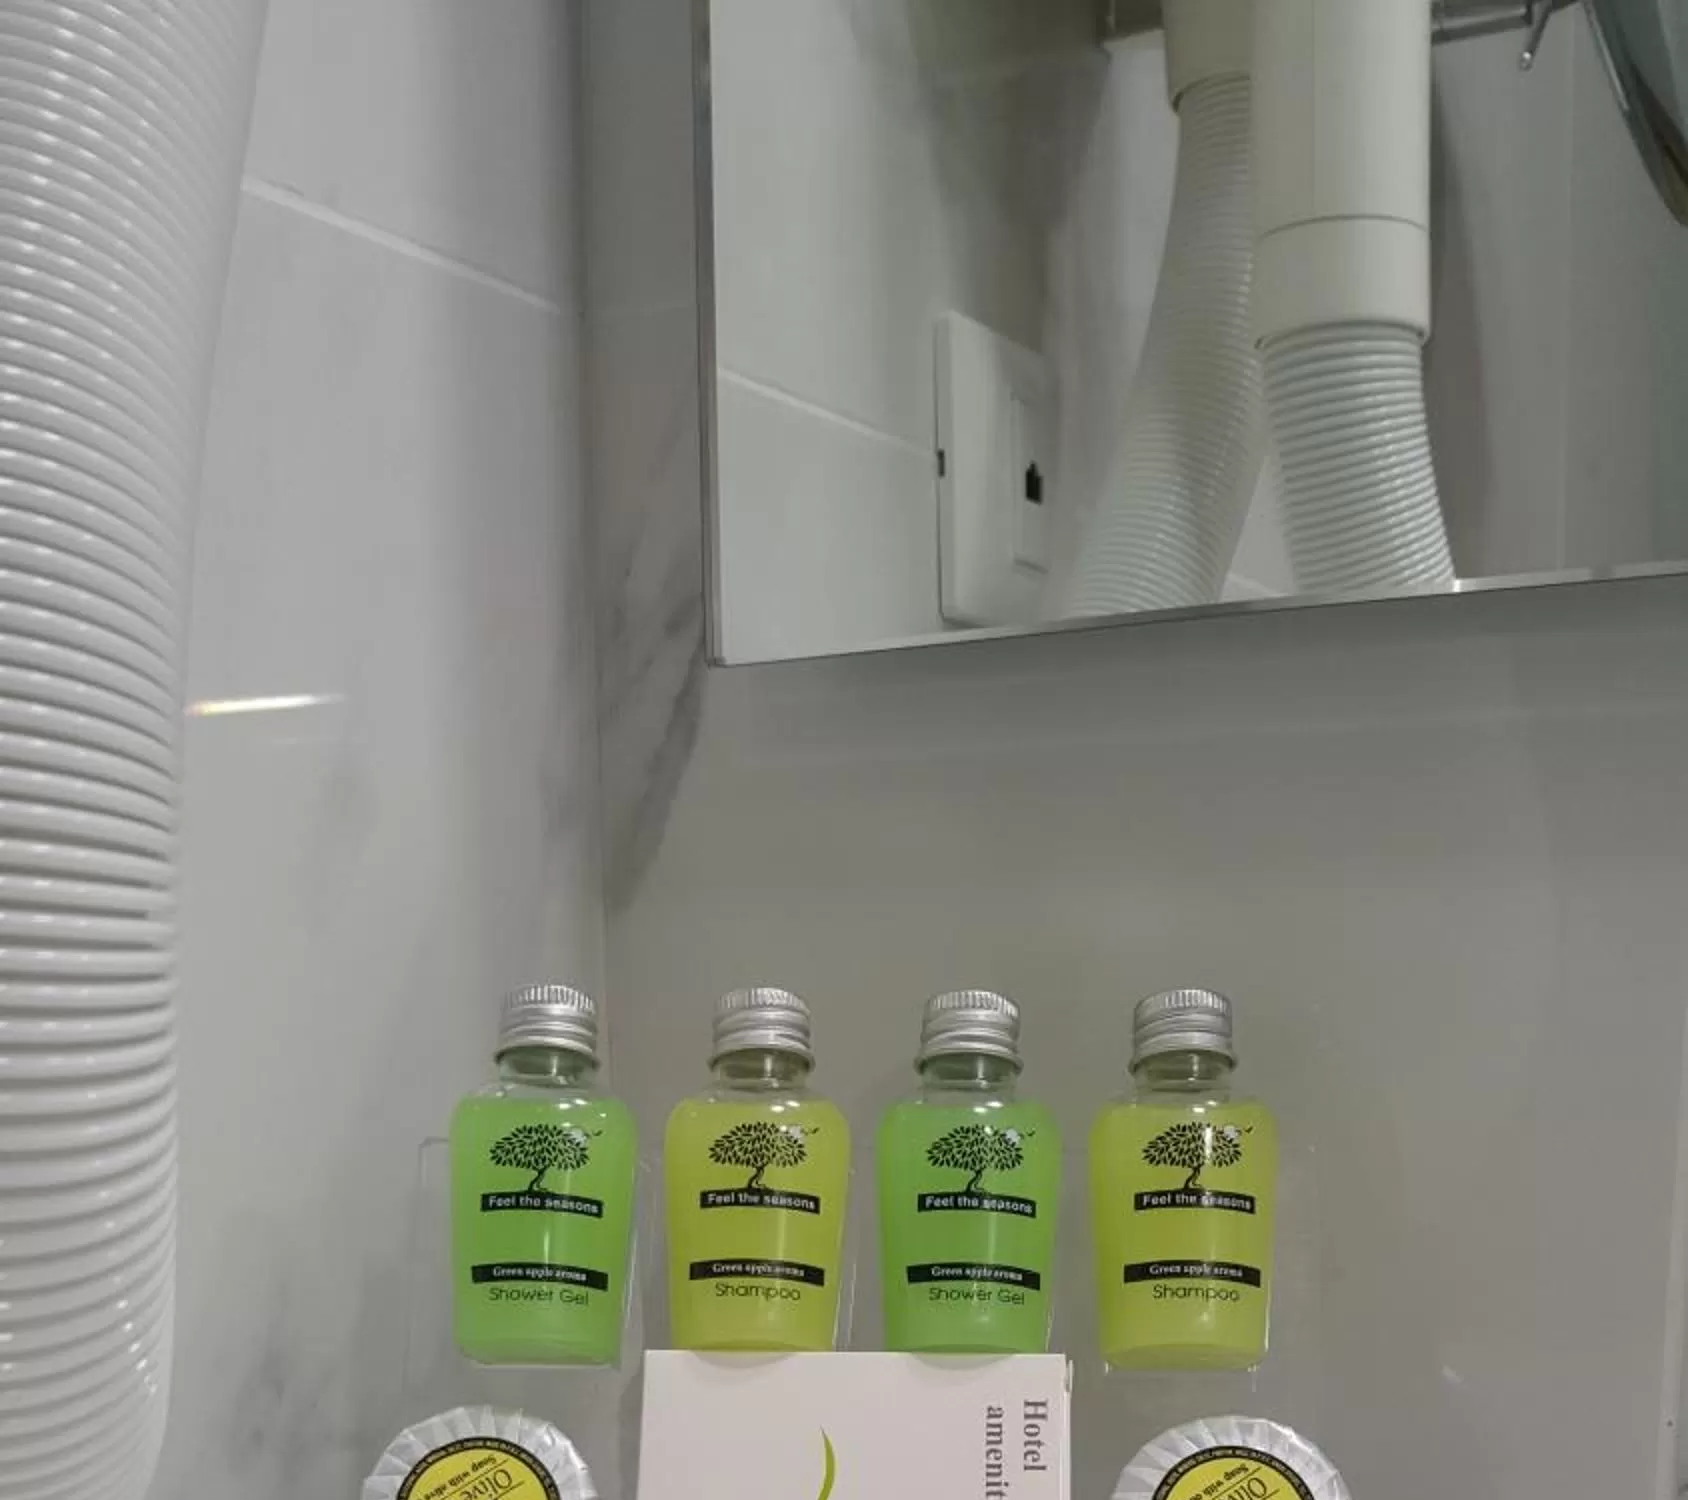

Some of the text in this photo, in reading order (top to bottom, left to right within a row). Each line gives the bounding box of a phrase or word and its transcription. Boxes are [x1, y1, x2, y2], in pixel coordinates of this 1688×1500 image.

[489, 1195, 599, 1214] Feel the seasons
[707, 1192, 816, 1210] Feel the seasons
[925, 1195, 1033, 1214] Feel the seasons
[1143, 1193, 1251, 1210] Feel the seasons
[493, 1266, 525, 1277] Green
[712, 1263, 743, 1273] Green
[931, 1266, 963, 1277] Green
[1149, 1264, 1181, 1275] Green
[490, 1287, 589, 1305] Shower Gel
[715, 1282, 801, 1302] Shampoo
[929, 1287, 1025, 1305] Shower Gel
[1152, 1283, 1240, 1302] Shampoo
[1023, 1399, 1049, 1472] Hotel
[471, 1456, 497, 1473] Soap
[1224, 1464, 1250, 1481] Soap
[1203, 1477, 1225, 1496] with
